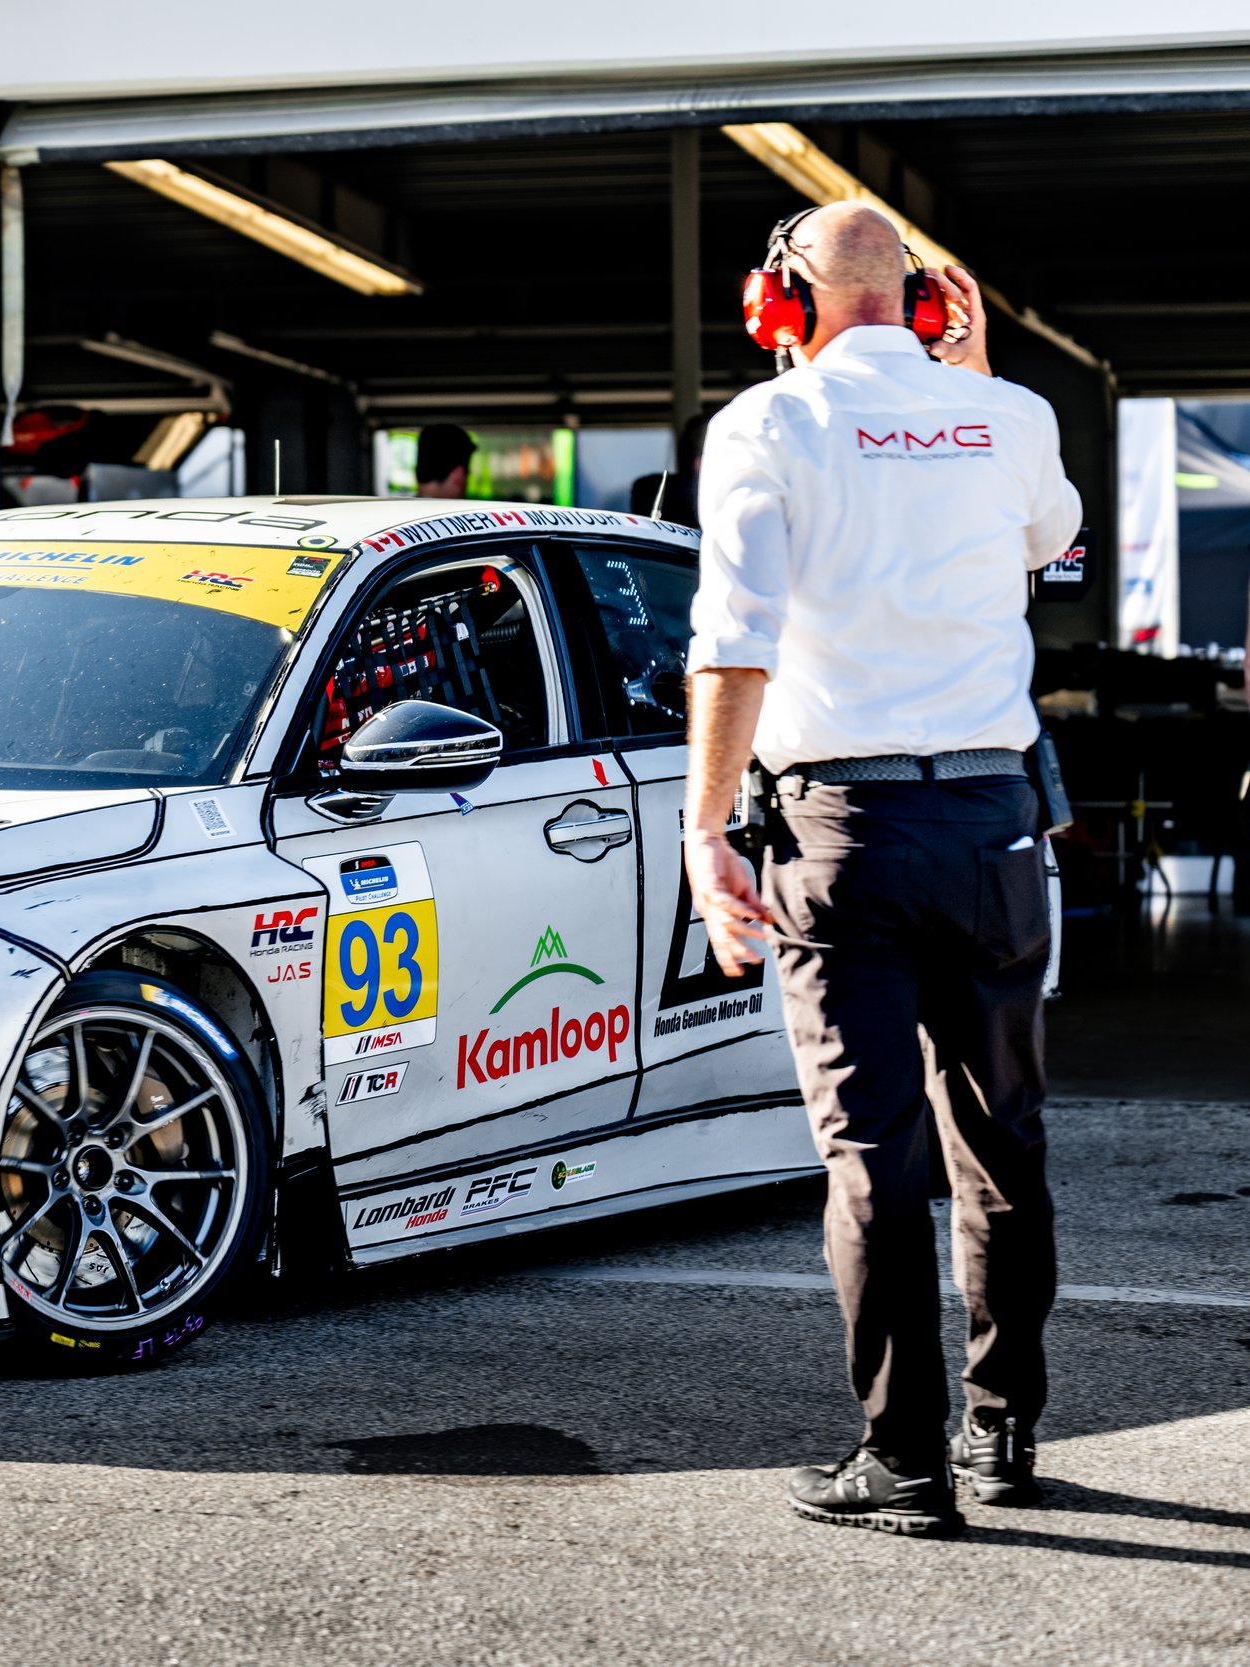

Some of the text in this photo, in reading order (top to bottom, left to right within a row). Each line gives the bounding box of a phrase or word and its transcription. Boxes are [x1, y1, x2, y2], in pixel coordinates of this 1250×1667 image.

[856, 425, 993, 451] MMG
[398, 512, 497, 544] WITTMER
[523, 510, 621, 526] MONTOUR
[181, 570, 254, 588] HRC
[251, 907, 318, 947] HRC
[250, 942, 313, 957] Honda RACING
[267, 962, 311, 984] JAS
[339, 911, 423, 1028] 93
[654, 993, 763, 1038] Honda Genuine Motor Oil
[370, 1032, 403, 1050] IMSA
[456, 1004, 630, 1090] Kamloop
[366, 1071, 398, 1093] TCR
[465, 1168, 537, 1203] PFC
[352, 1186, 456, 1230] Lombardi
[462, 1198, 499, 1211] BRAKES
[405, 1208, 448, 1230] Honda
